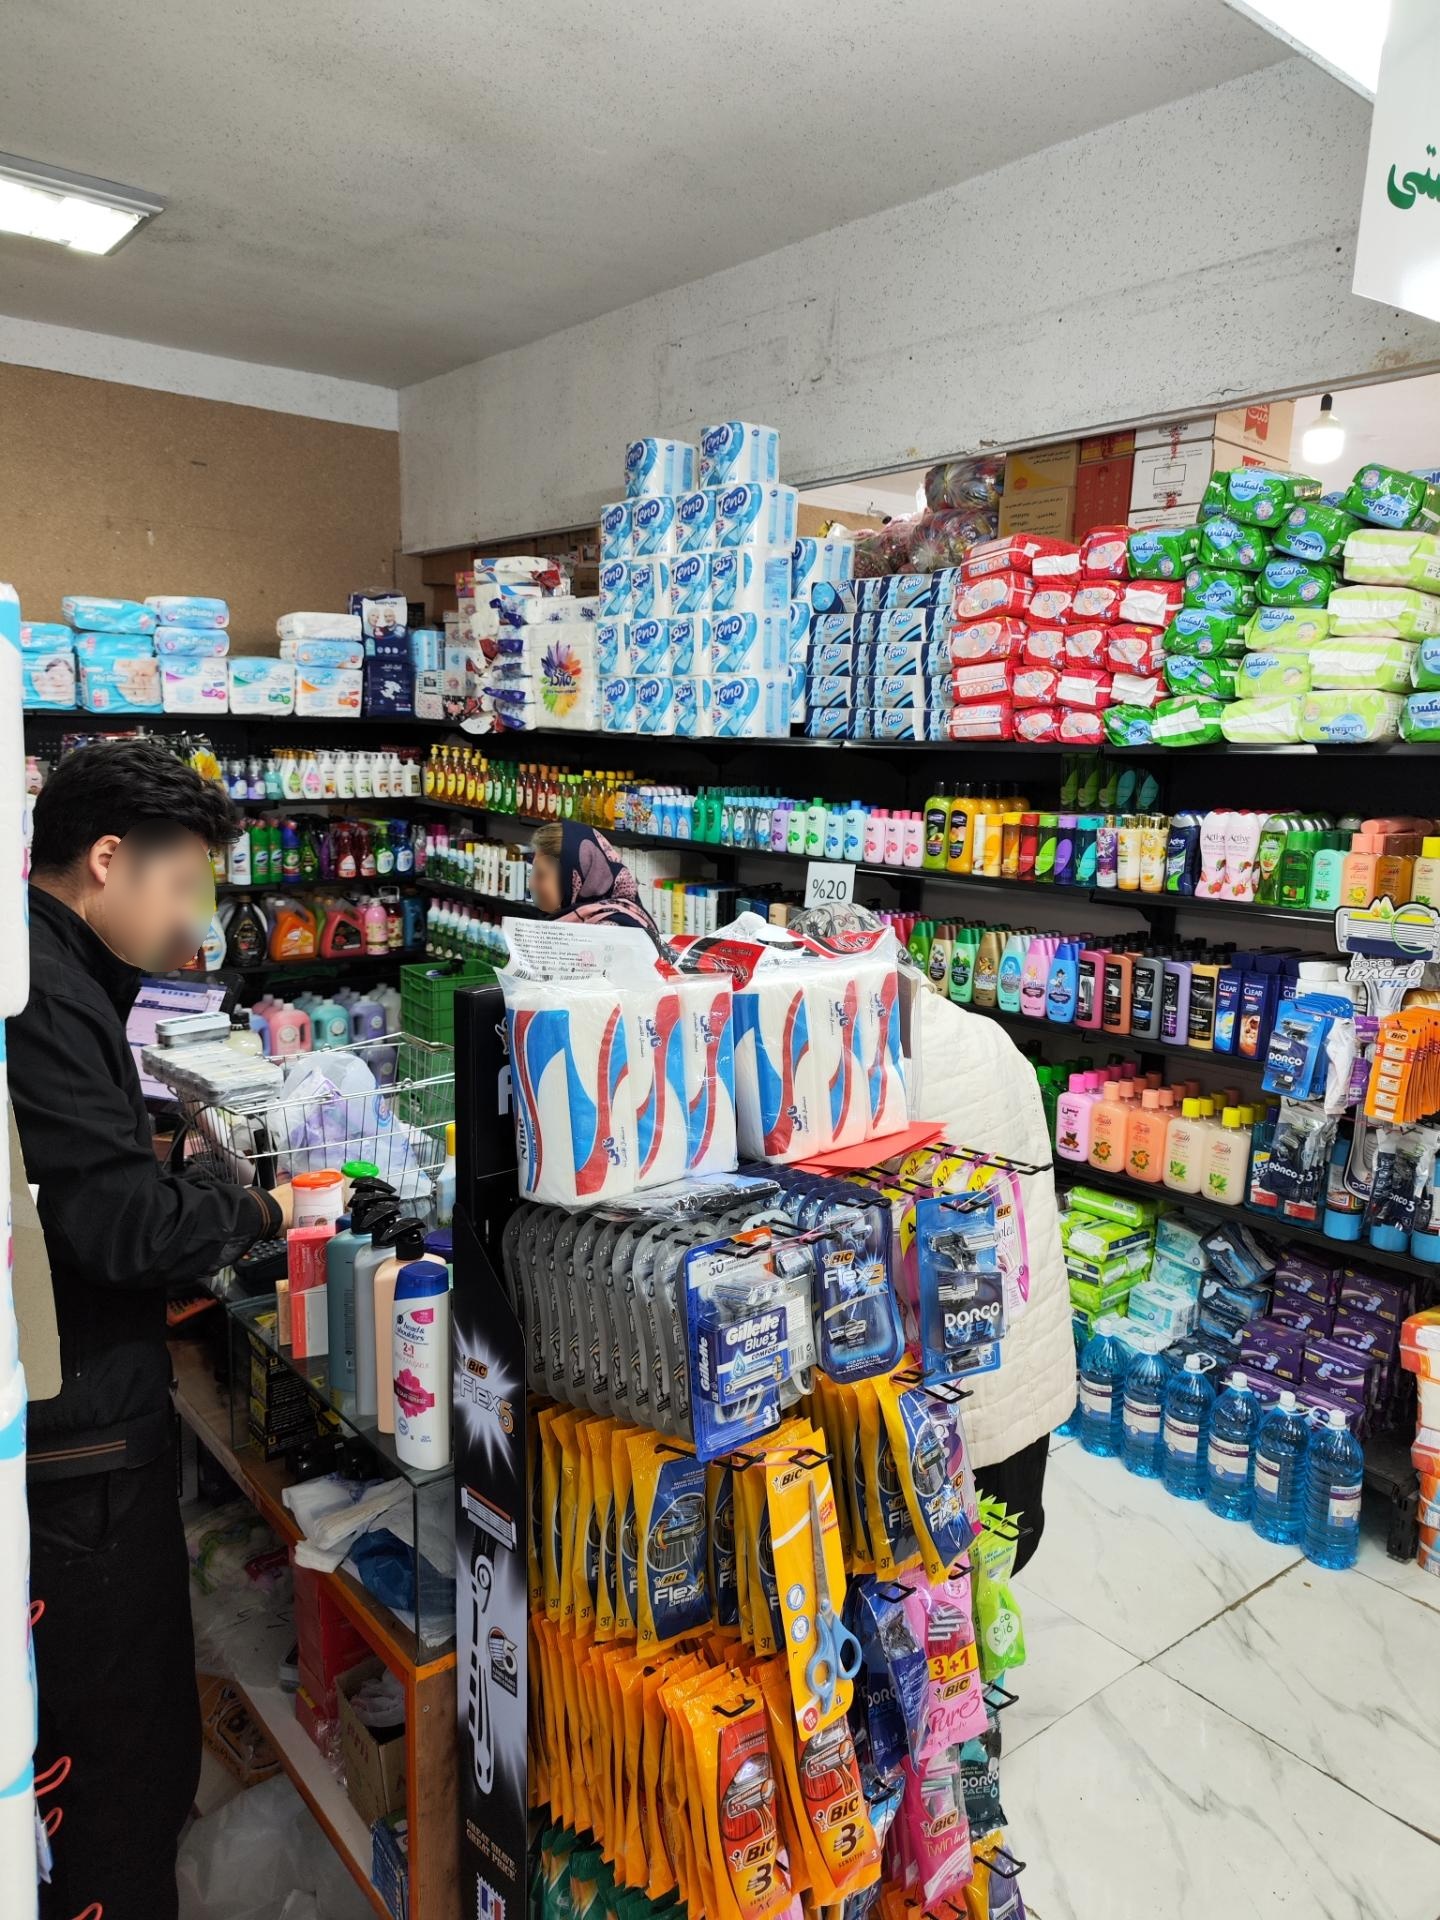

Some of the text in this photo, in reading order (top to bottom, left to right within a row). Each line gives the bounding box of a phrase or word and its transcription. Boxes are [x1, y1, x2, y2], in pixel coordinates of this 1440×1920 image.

[677, 495, 705, 522] Teno
[719, 488, 748, 516] Teno
[634, 501, 660, 526] Teno
[600, 564, 624, 585] Teno
[671, 559, 698, 584] Teno
[631, 622, 657, 645] Teno
[713, 618, 741, 642] Teno
[823, 647, 841, 660] Teno
[888, 647, 907, 659] Teno
[716, 685, 742, 705] Teno
[884, 680, 904, 694] Teno
[885, 711, 903, 724] Teno
[812, 878, 847, 900] %20
[1219, 983, 1237, 993] CLEAR
[1244, 988, 1263, 998] CLEAR
[1268, 1051, 1303, 1067] DORCO
[1405, 1200, 1416, 1213] 3
[944, 1301, 1001, 1328] DORCO
[726, 1313, 781, 1346] Gillette
[700, 1335, 709, 1391] Gillette
